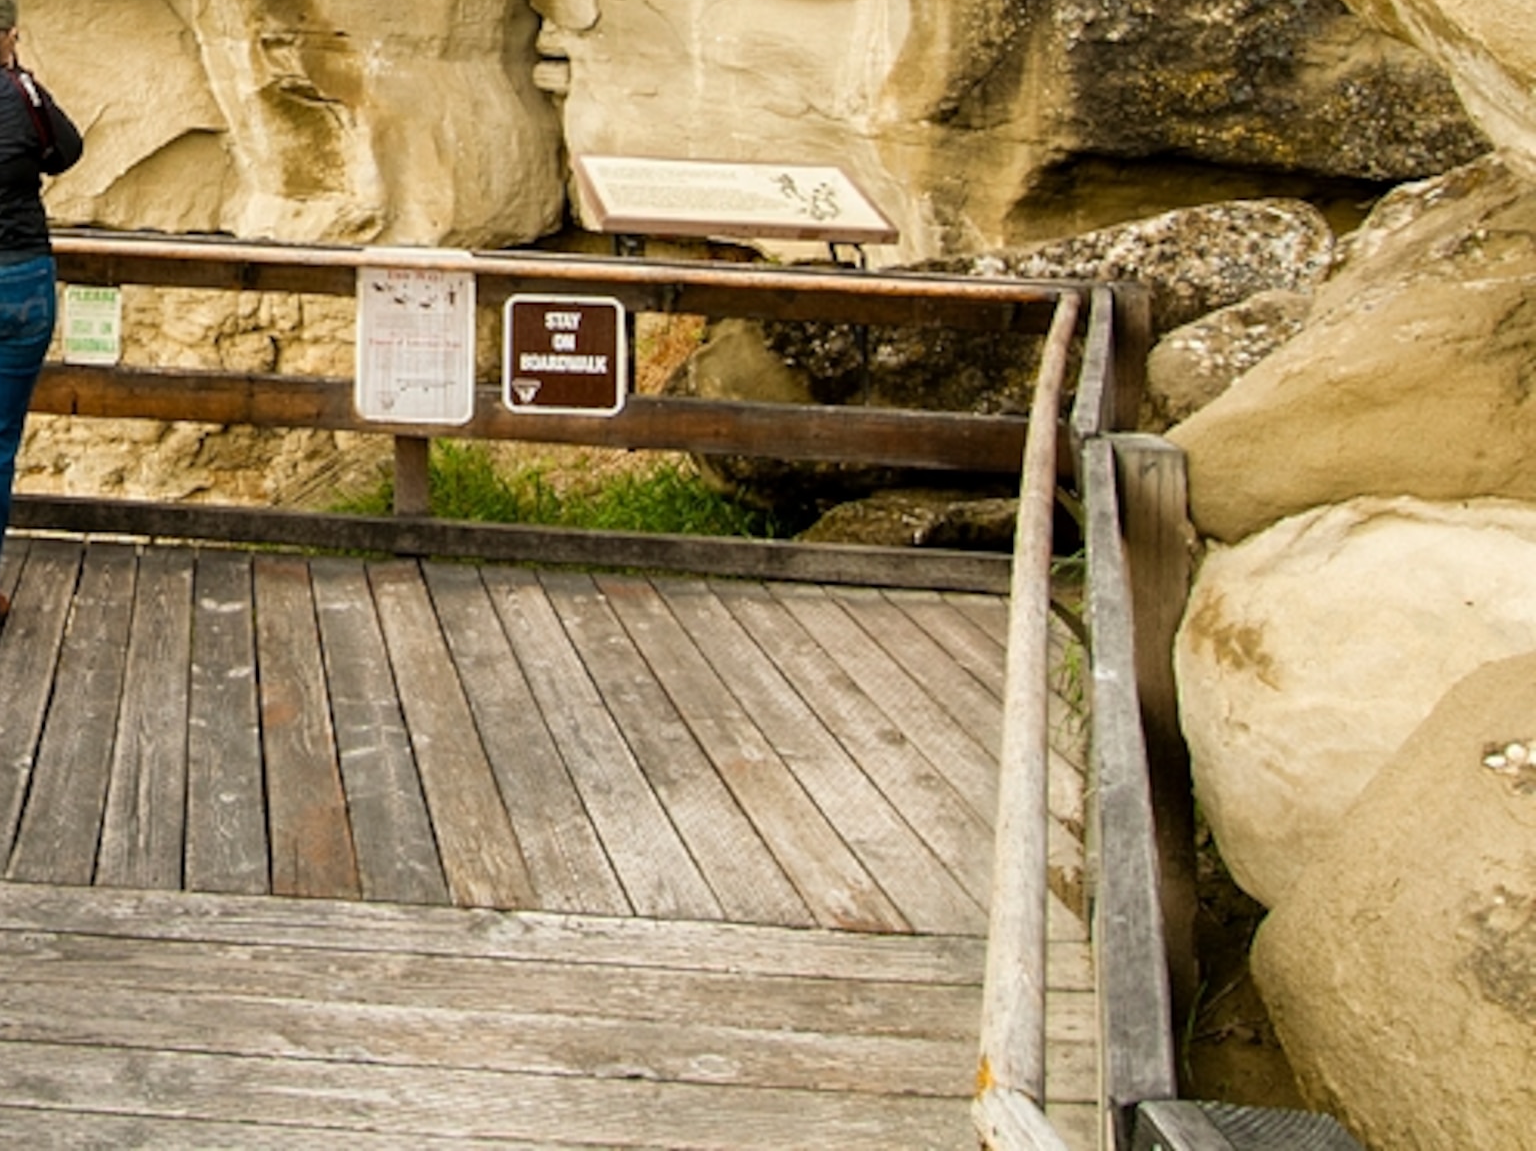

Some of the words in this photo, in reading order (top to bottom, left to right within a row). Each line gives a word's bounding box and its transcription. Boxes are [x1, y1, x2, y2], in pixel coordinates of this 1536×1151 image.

[68, 291, 116, 302] PLEASE
[545, 311, 582, 330] STAY
[552, 333, 577, 351] ON
[519, 354, 608, 374] BOARDWALK
